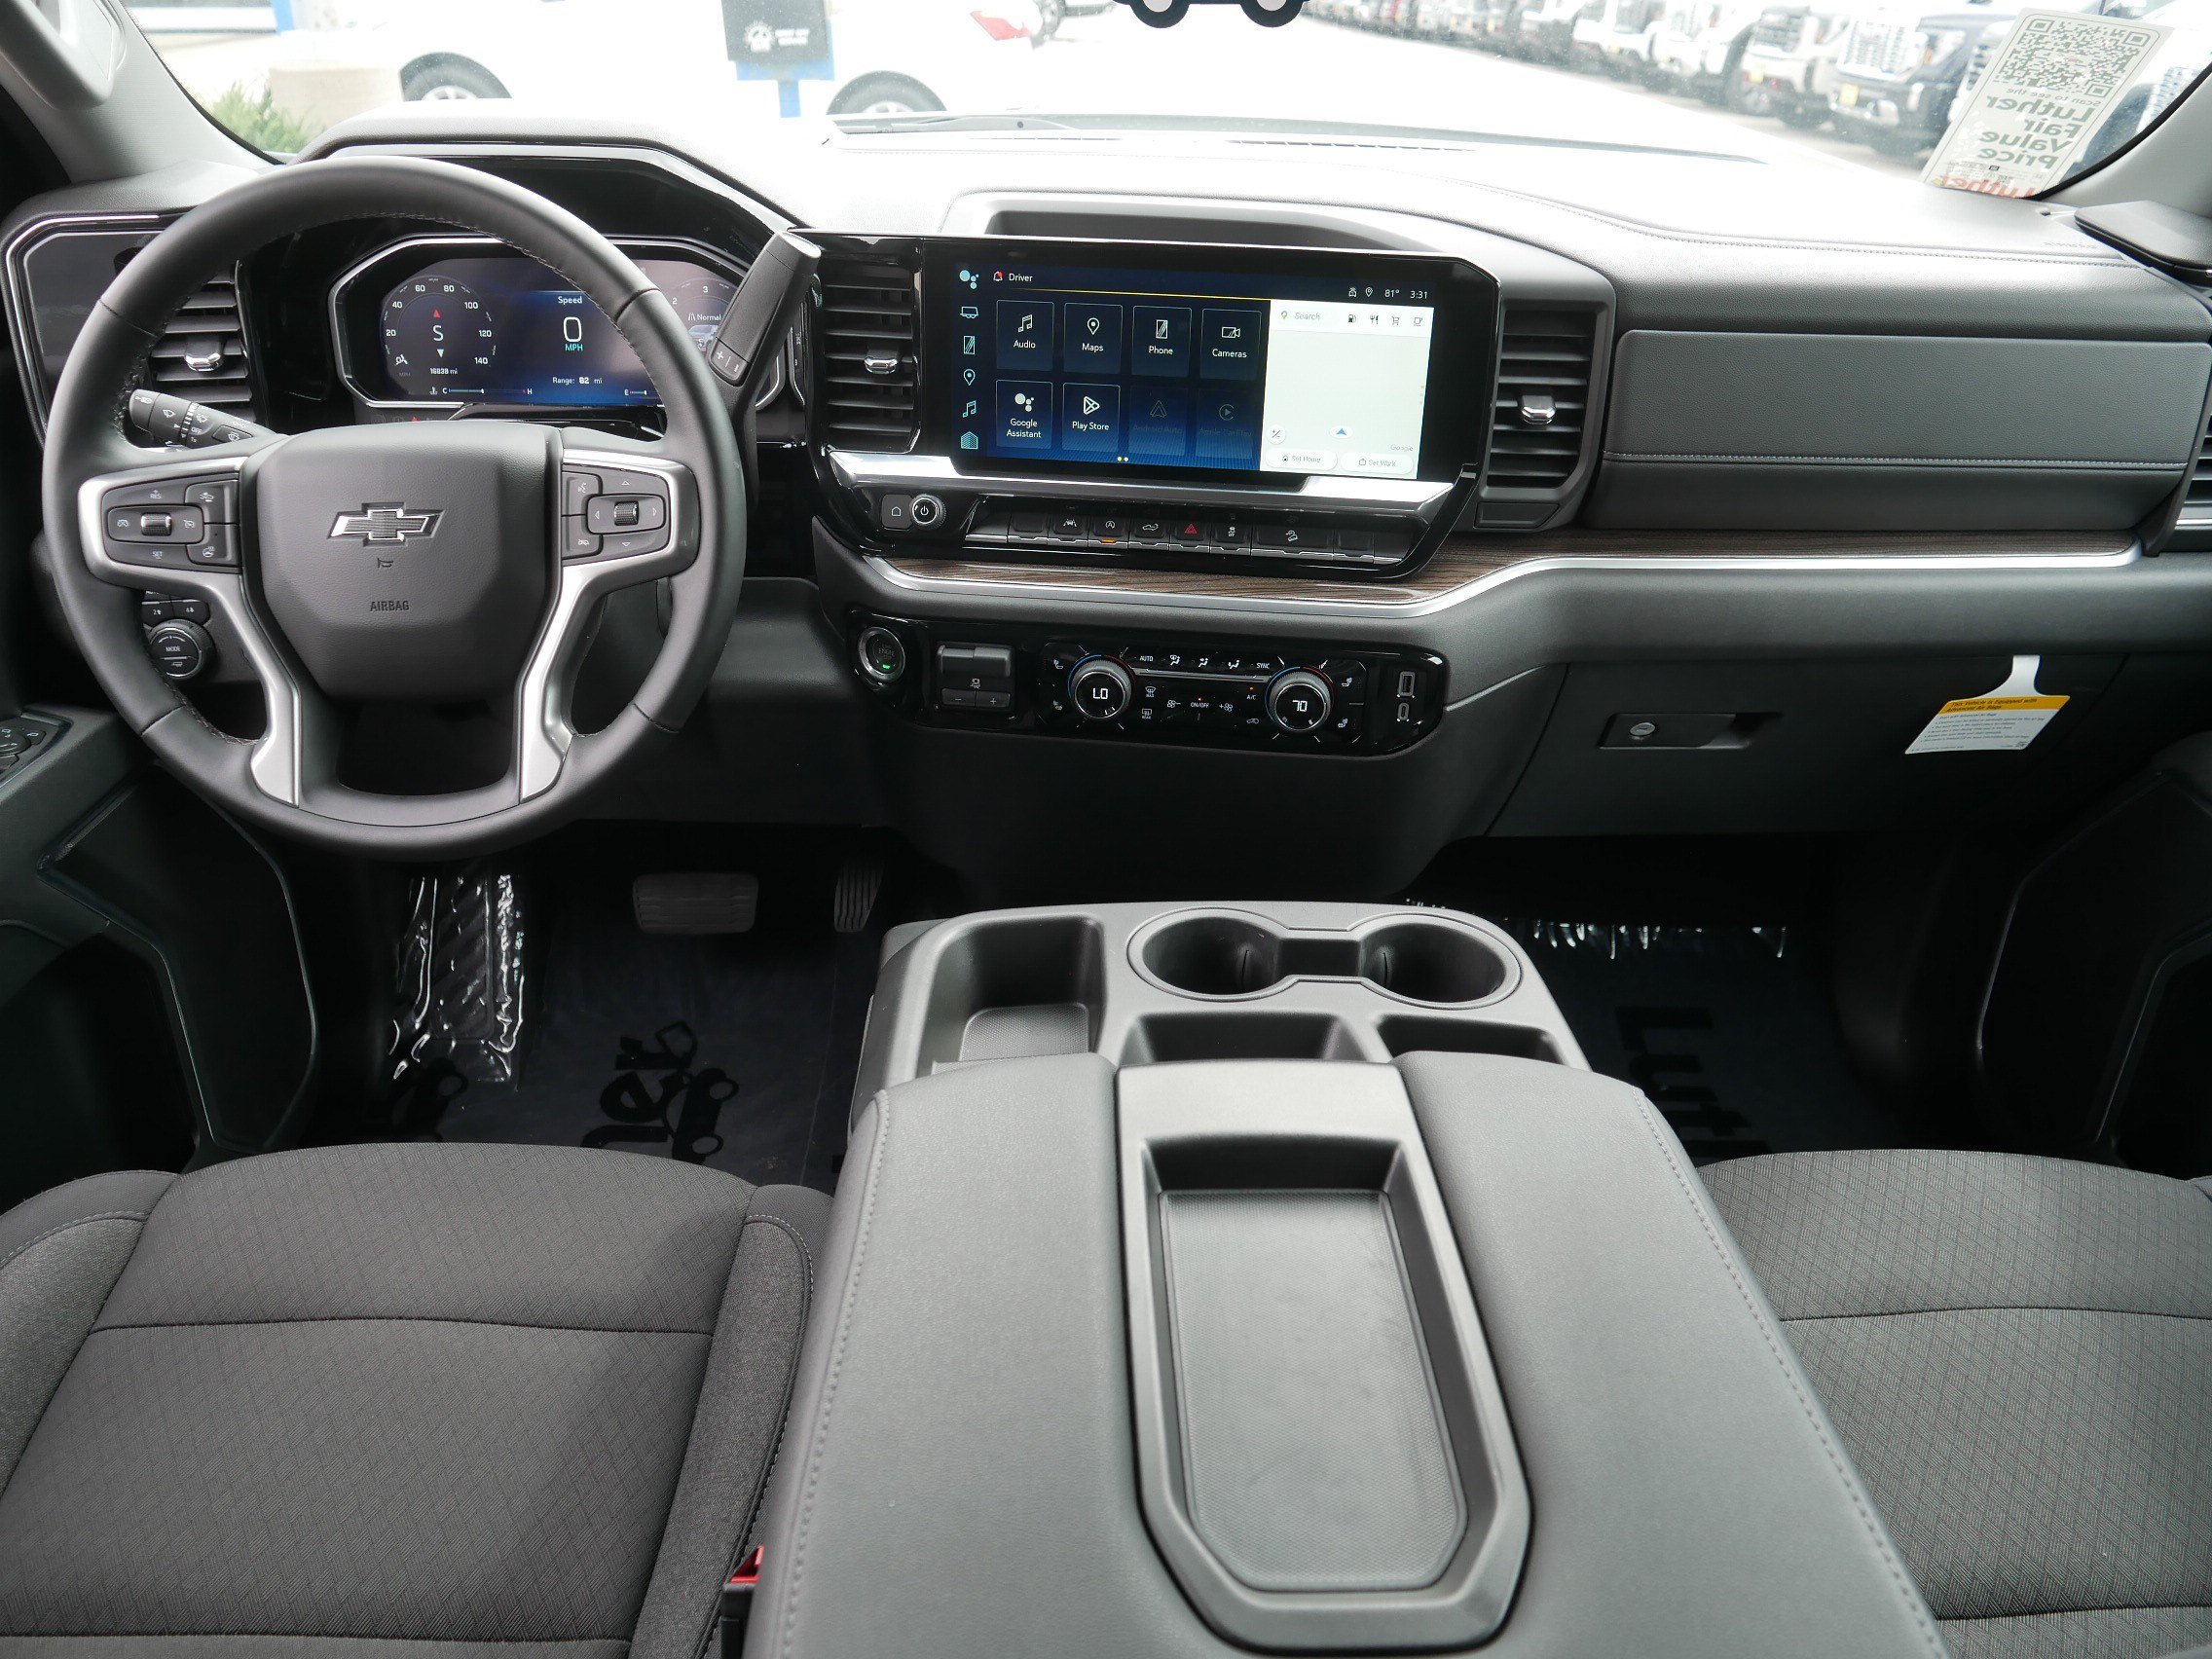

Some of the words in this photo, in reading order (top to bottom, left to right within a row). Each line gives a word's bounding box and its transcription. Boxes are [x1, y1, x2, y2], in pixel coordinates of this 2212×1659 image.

[1009, 273, 1033, 282] Driver
[1384, 288, 1400, 297] 81°
[1410, 290, 1428, 299] 3:31
[558, 296, 582, 305] Speed
[1294, 312, 1321, 320] Search
[432, 324, 444, 342] S
[563, 316, 582, 343] 0
[1013, 340, 1036, 350] Audio
[1082, 343, 1104, 353] Maps
[1148, 345, 1174, 356] Phone
[1212, 348, 1247, 359] Cameras
[552, 377, 575, 386] Range:
[1010, 418, 1038, 429] Google
[1072, 421, 1087, 431] Play
[1088, 422, 1110, 431] Store
[1006, 429, 1042, 439] Assistant
[370, 600, 410, 611] AIRBAG
[1092, 687, 1109, 700] LO
[1292, 699, 1308, 713] 70
